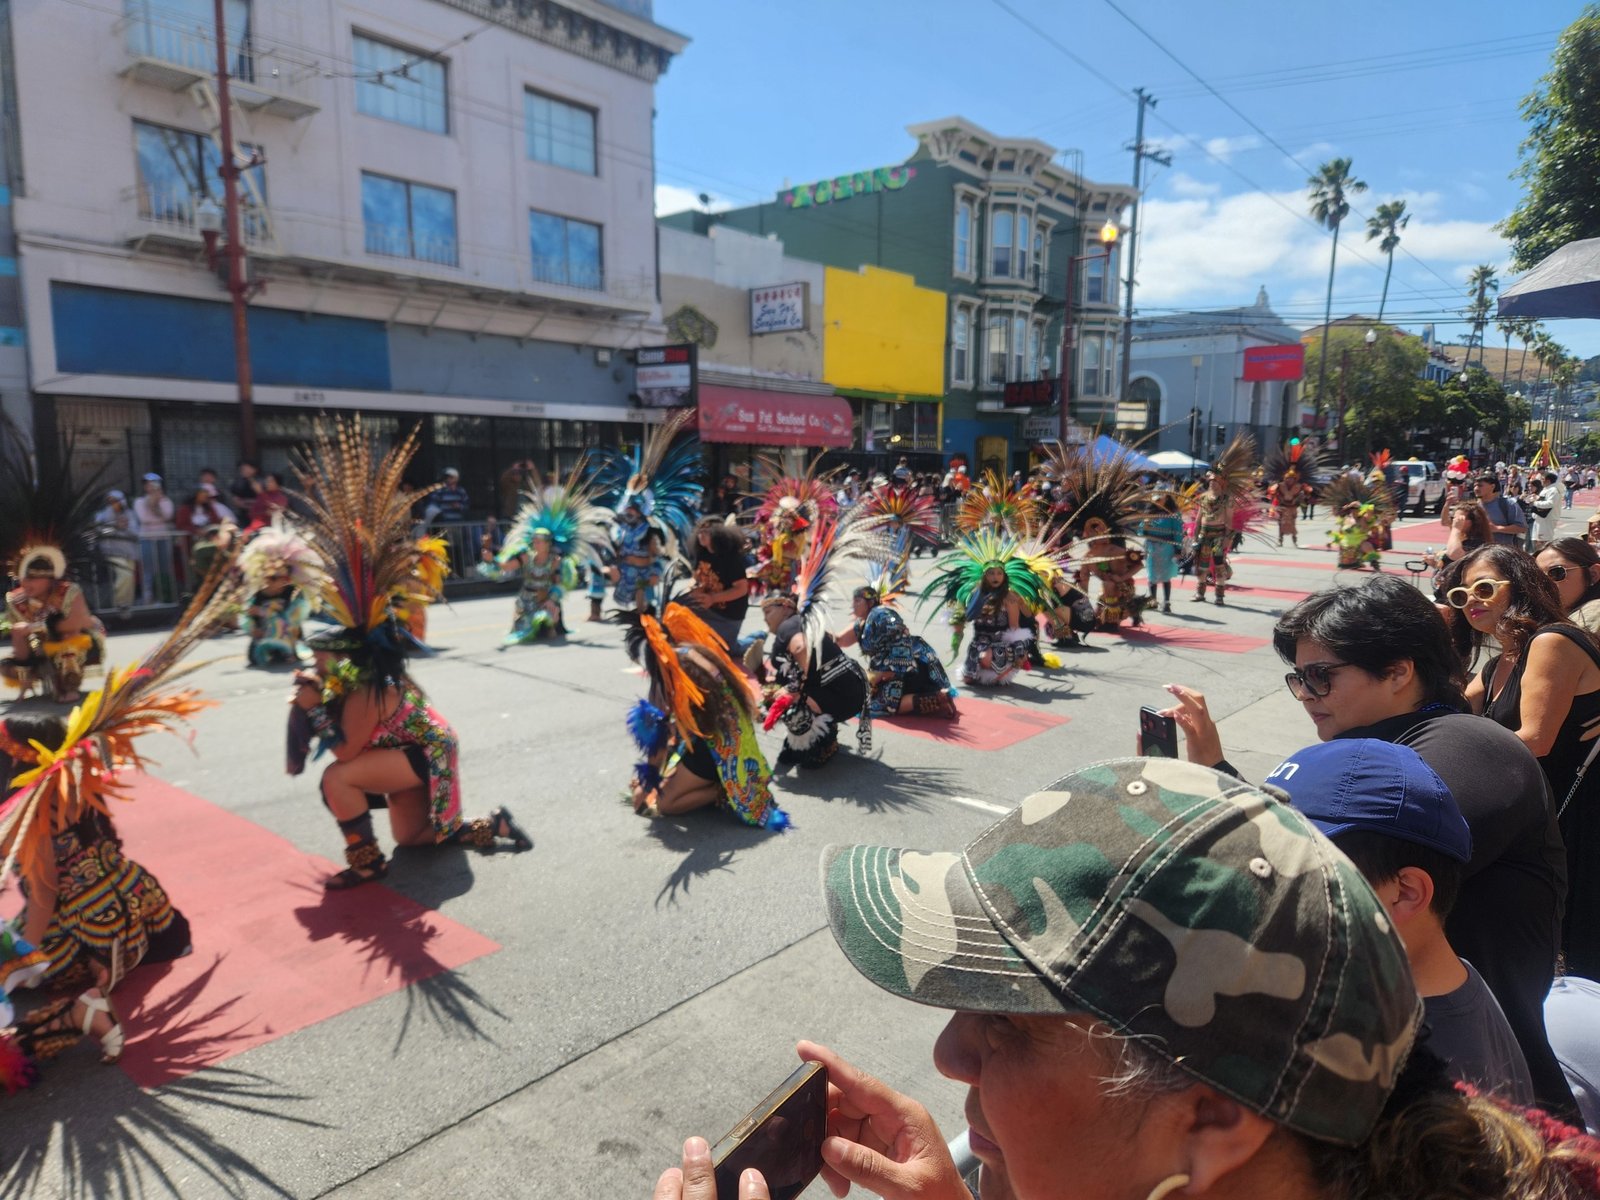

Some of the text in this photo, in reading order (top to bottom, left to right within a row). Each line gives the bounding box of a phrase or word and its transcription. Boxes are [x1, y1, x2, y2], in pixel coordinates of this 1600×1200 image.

[760, 304, 777, 318] Sun
[739, 409, 755, 423] Sun
[776, 412, 806, 427] Seafood
[1025, 428, 1054, 437] HOTEL
